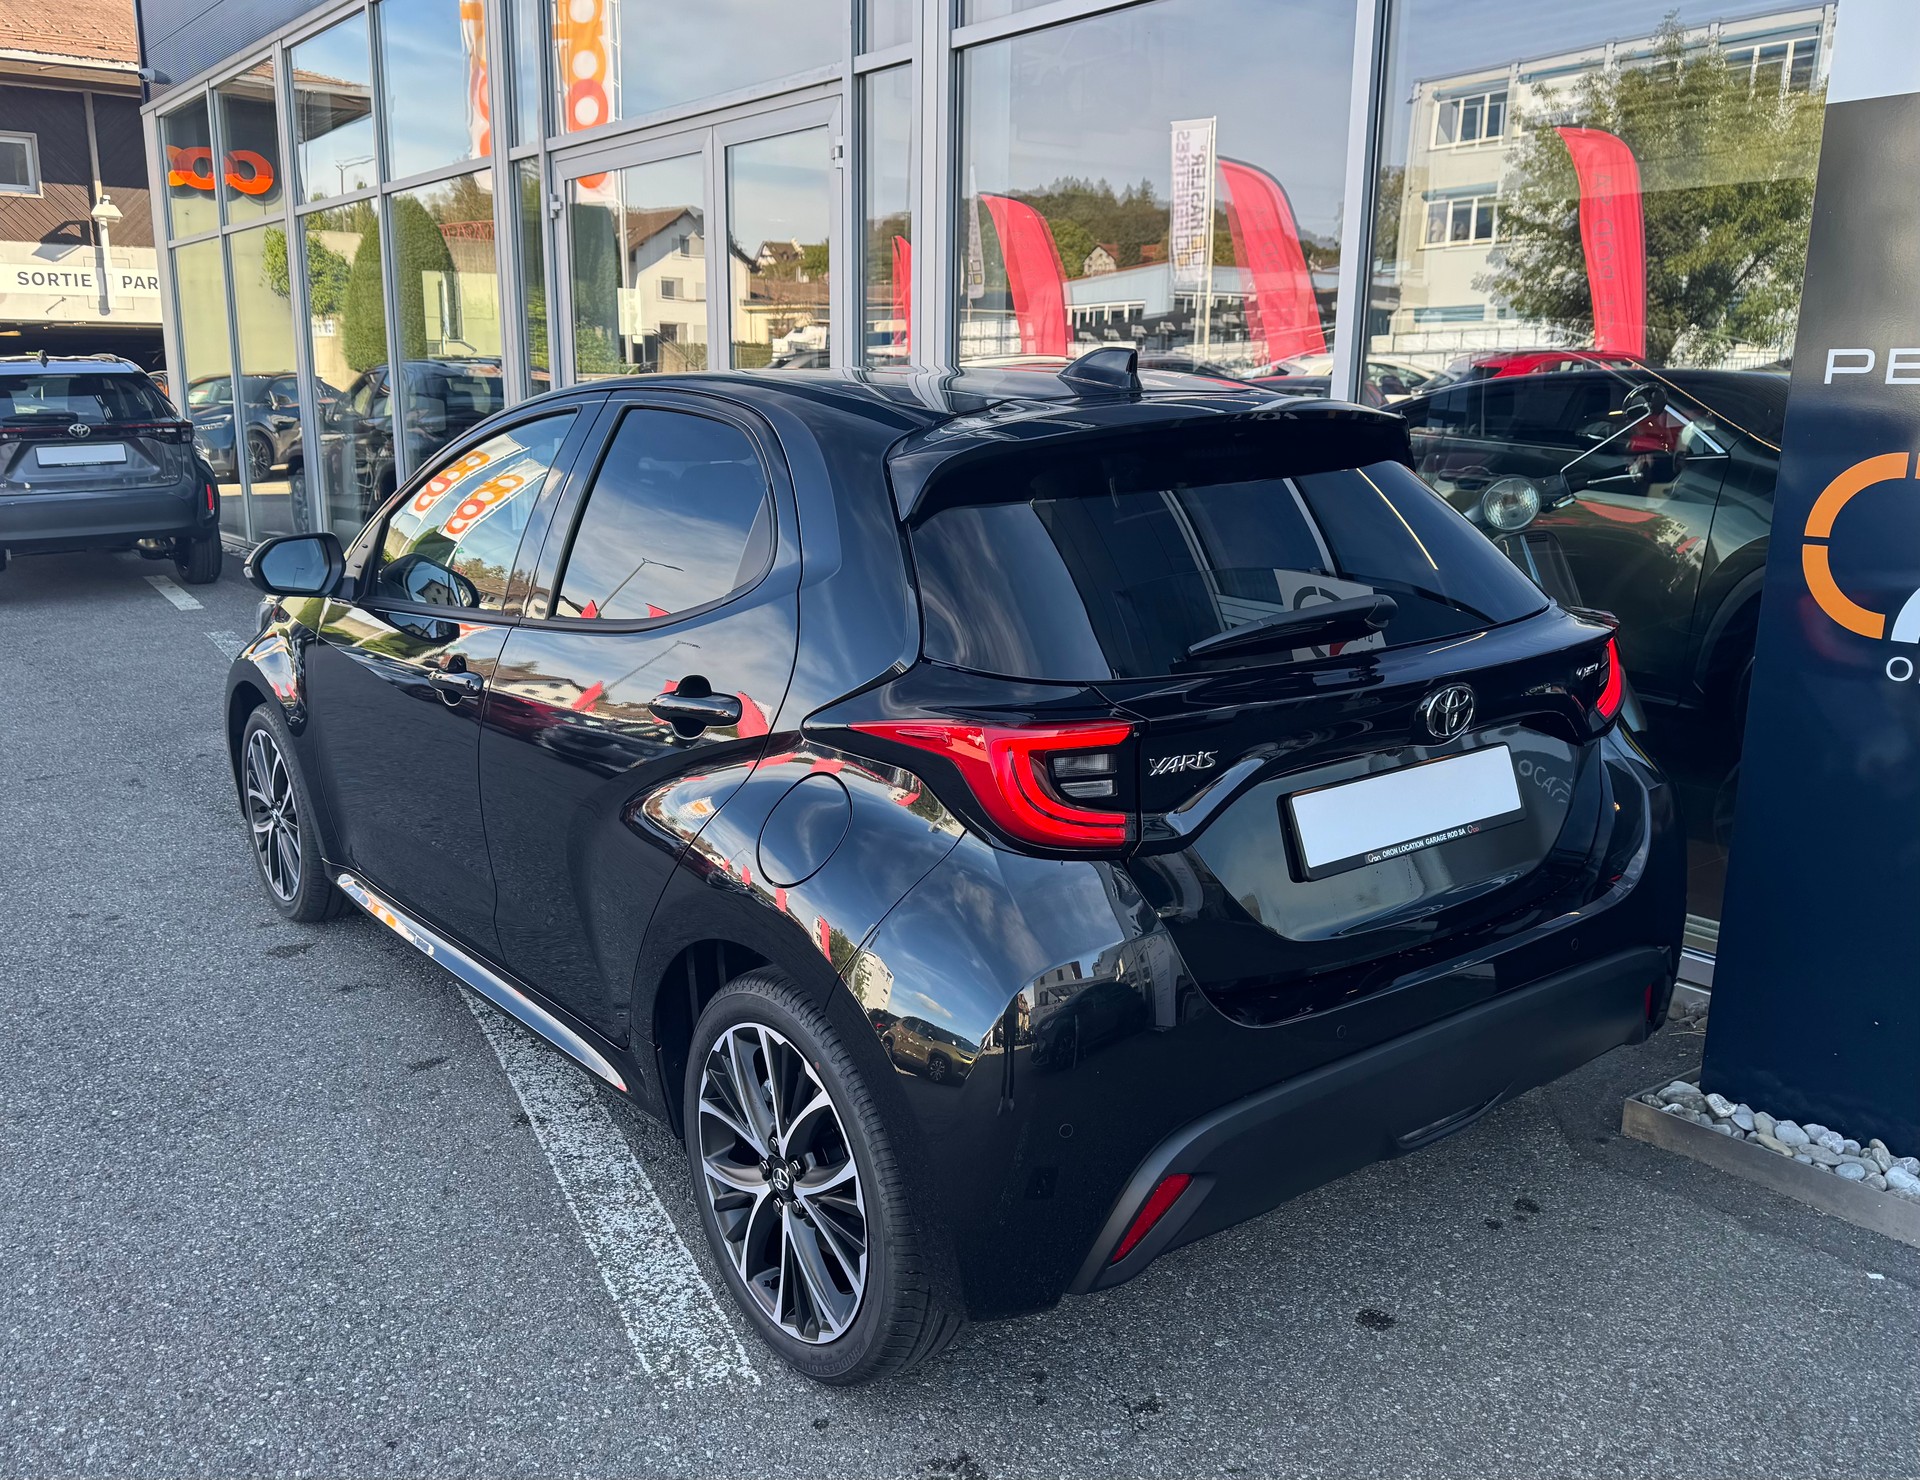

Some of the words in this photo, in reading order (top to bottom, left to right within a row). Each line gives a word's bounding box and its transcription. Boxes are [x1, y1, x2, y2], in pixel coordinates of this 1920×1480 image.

[17, 271, 93, 288] SORTIE
[1382, 847, 1399, 858] ORON
[1399, 840, 1425, 854] LOCATION
[1425, 833, 1448, 845] GARAGE
